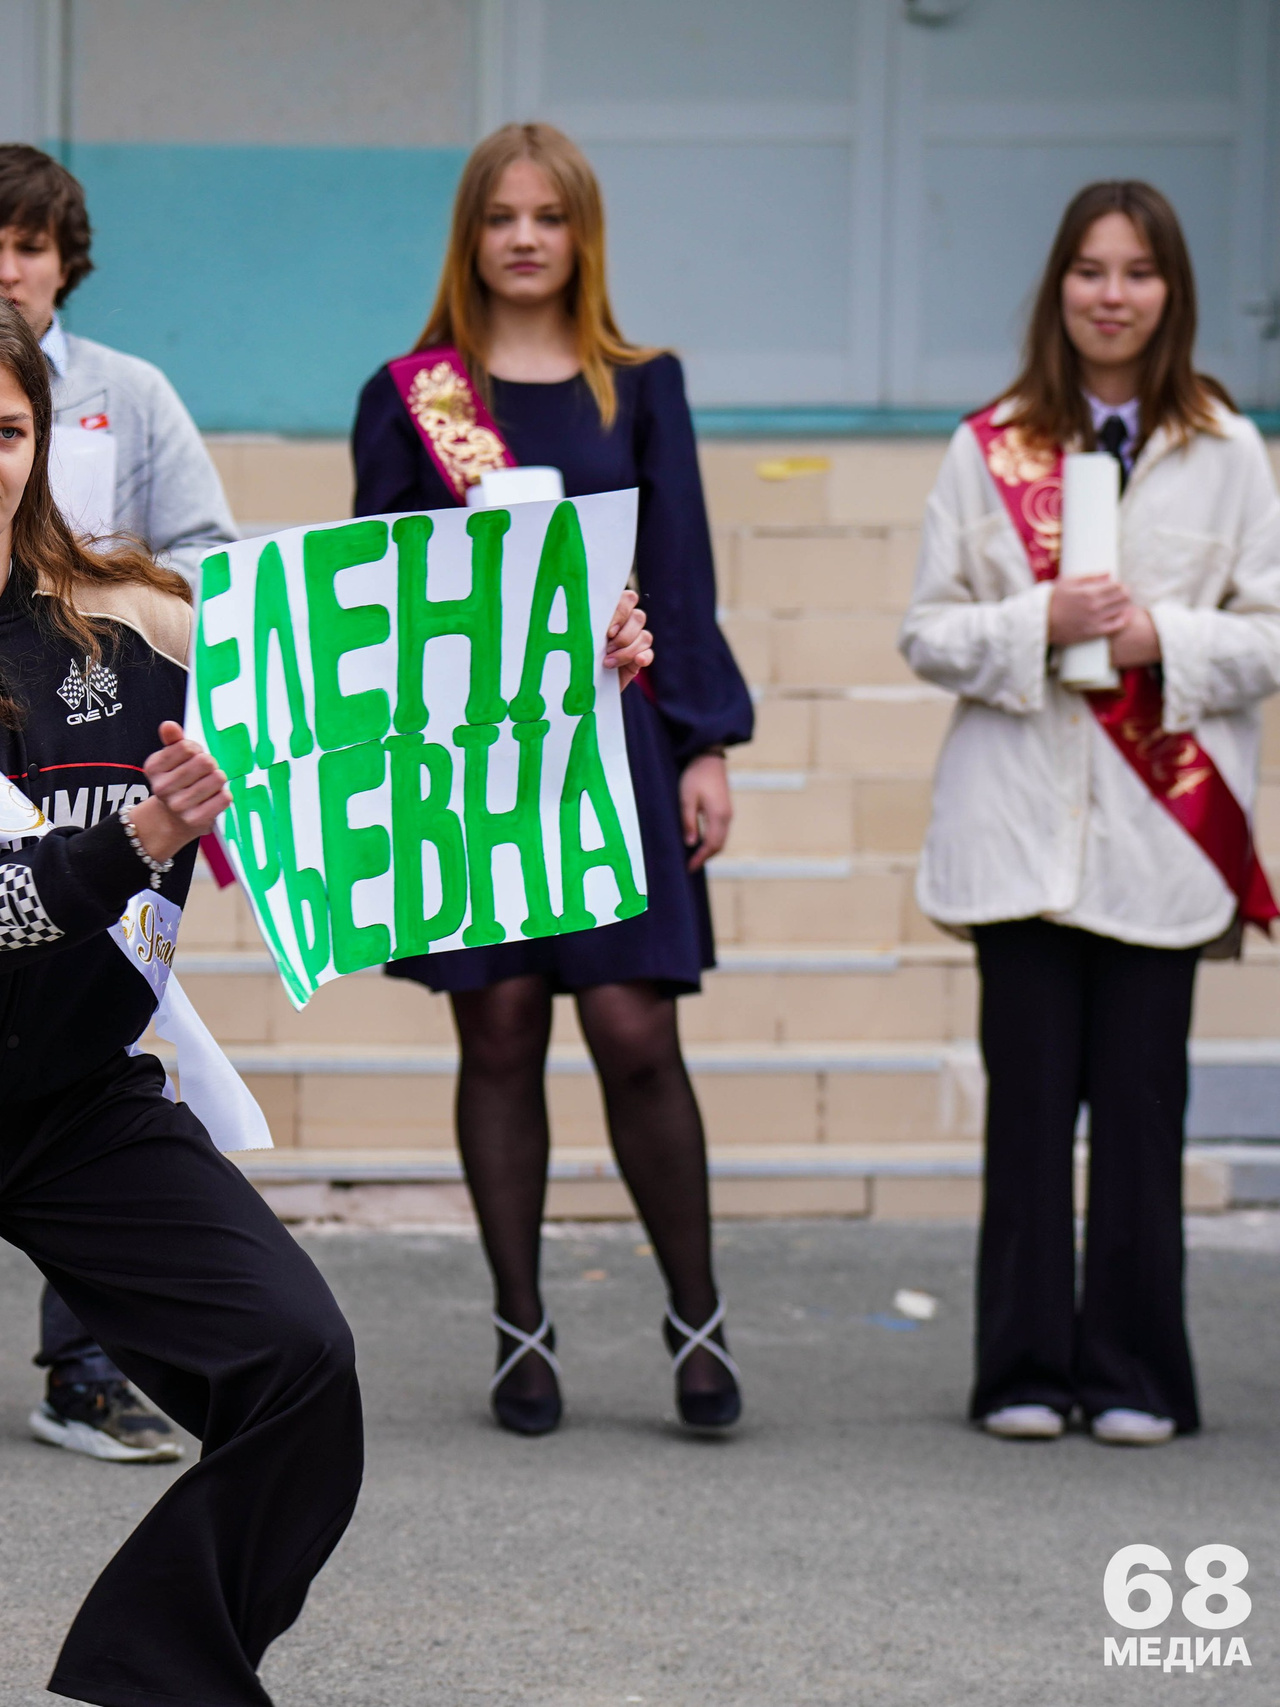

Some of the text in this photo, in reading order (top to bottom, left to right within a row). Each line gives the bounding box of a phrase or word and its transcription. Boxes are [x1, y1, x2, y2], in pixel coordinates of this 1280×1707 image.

[104, 702, 123, 717] UP
[196, 500, 596, 780] ЕЛЕНА
[224, 711, 648, 1004] РЬЕВНА
